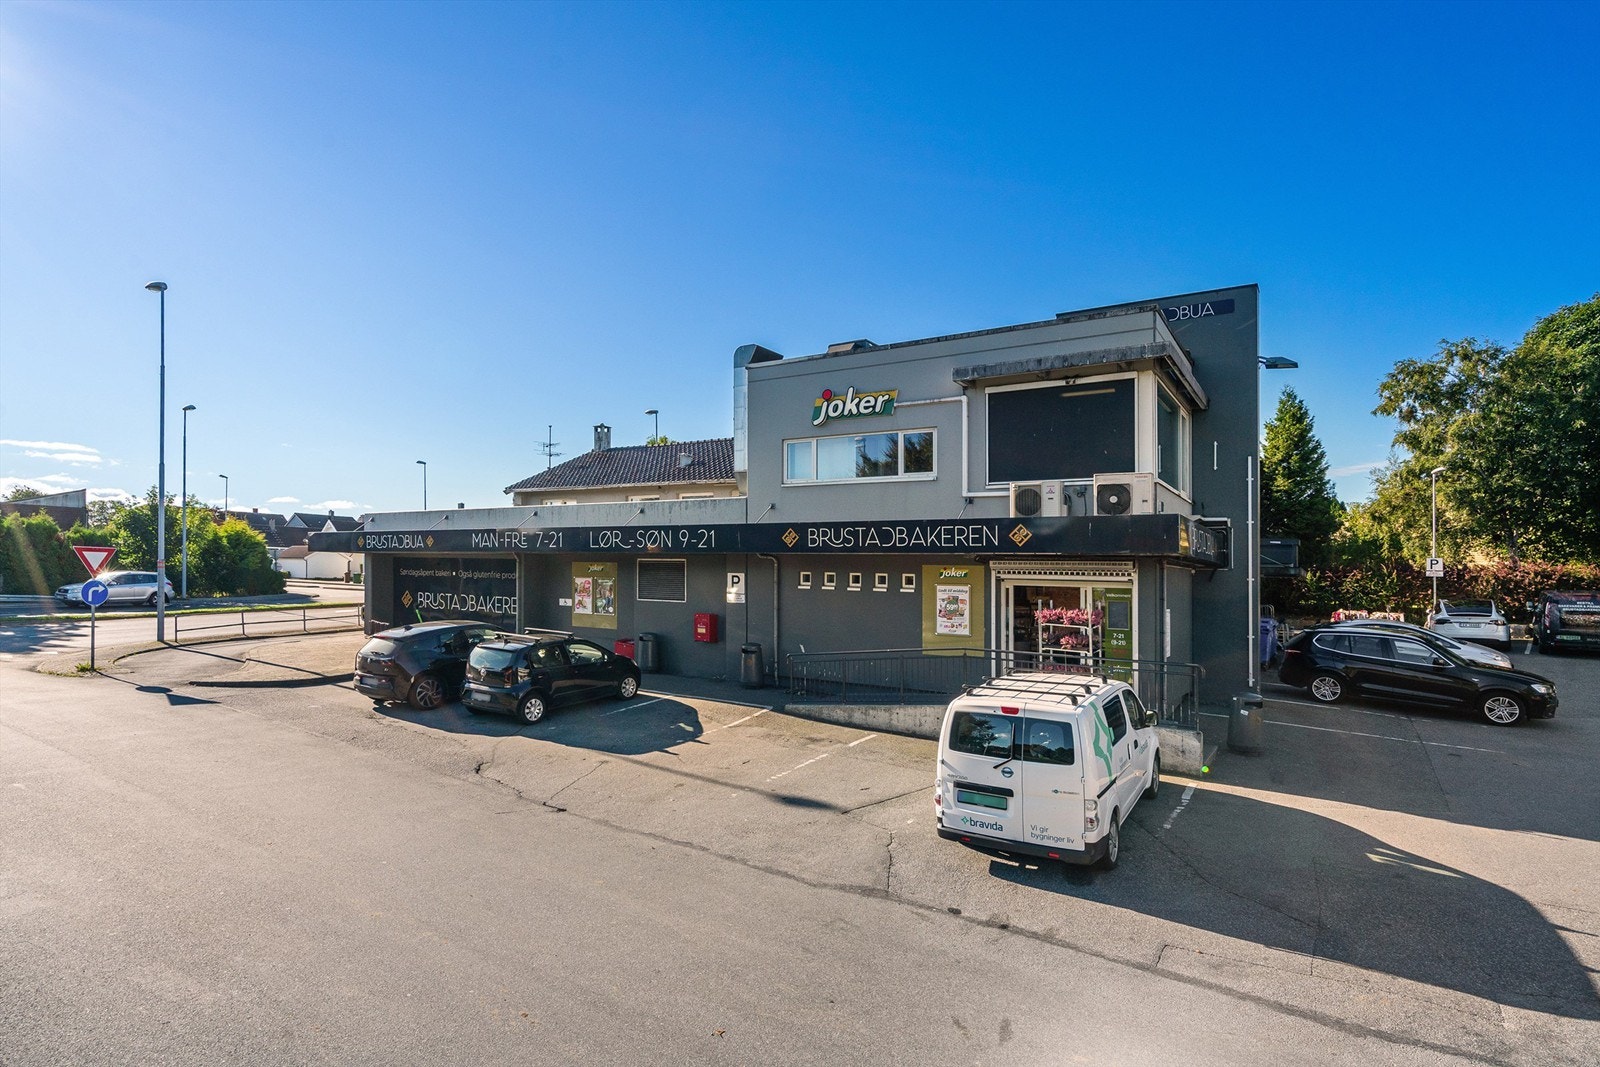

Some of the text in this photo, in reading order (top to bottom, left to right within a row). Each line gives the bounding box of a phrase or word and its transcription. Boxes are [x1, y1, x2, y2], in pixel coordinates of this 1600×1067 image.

[812, 386, 890, 426] joker
[365, 534, 425, 549] BRUSTADBUA
[471, 531, 563, 549] MAN-FRE 7-21
[589, 529, 716, 549] LØR-SØN 9-21
[807, 525, 999, 548] BRUSTADBAKEREN
[1430, 559, 1439, 570] P
[940, 567, 966, 579] joker
[731, 575, 741, 589] P
[969, 816, 1004, 832] bravida
[1039, 825, 1049, 833] gir
[1030, 831, 1075, 844] bygninger liv
